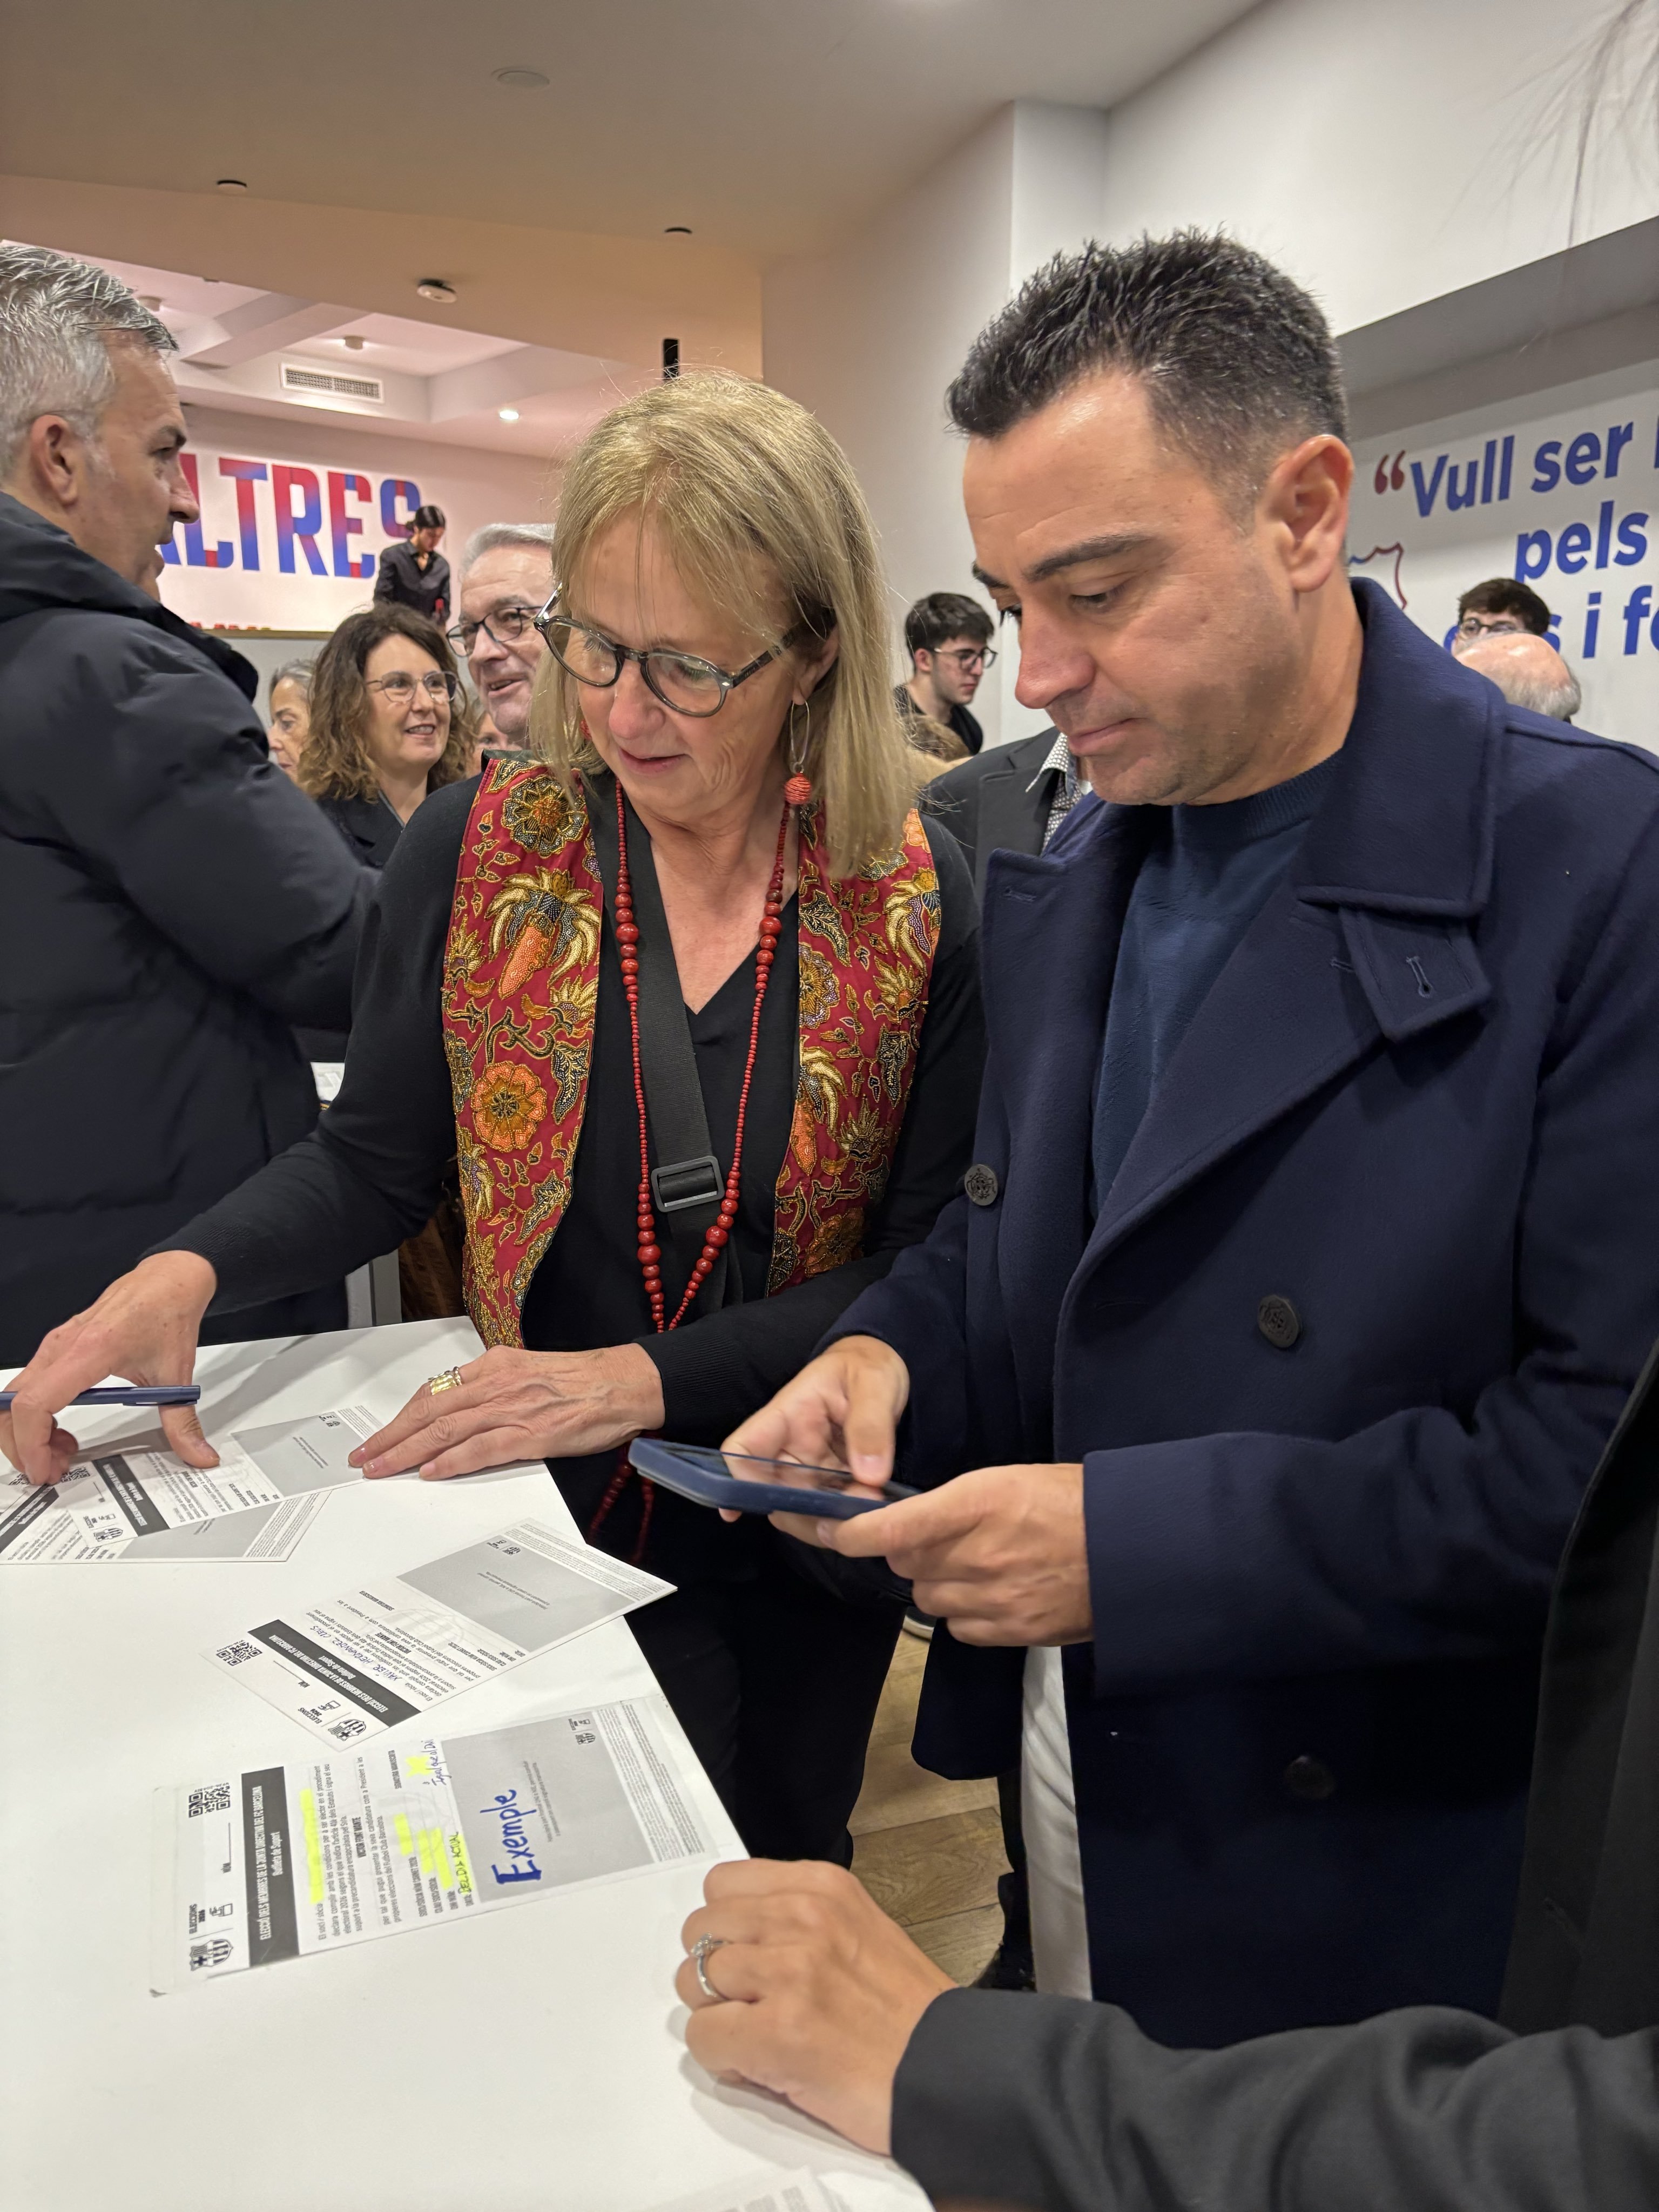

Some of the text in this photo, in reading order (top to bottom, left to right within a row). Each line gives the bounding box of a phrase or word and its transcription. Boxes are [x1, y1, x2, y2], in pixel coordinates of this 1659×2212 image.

[1530, 421, 1634, 493] ser
[1514, 500, 1649, 583] pels
[1582, 591, 1602, 659] i
[1623, 585, 1659, 656] f
[480, 1789, 542, 1884] Exemple
